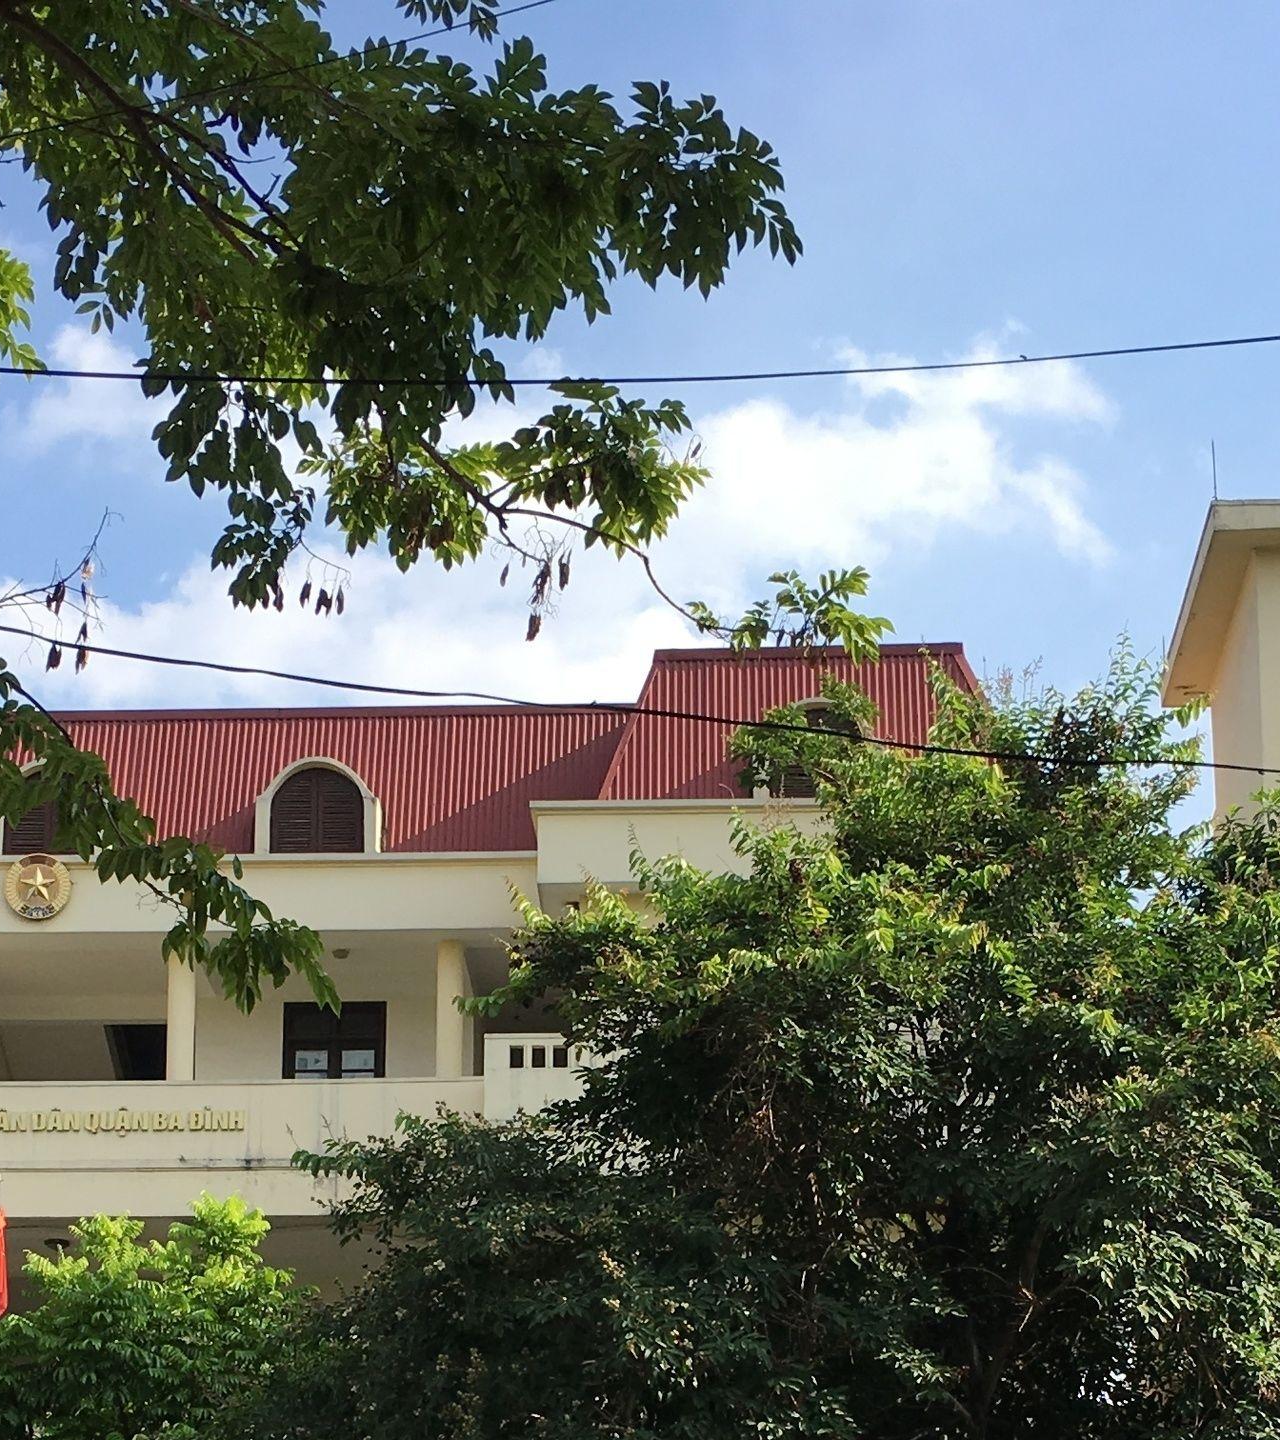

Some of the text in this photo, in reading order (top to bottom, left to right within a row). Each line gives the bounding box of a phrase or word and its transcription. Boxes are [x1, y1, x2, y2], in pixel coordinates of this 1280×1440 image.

[31, 1108, 80, 1132] DÂN
[84, 1107, 149, 1137] QUẬN
[152, 1111, 184, 1132] BA
[189, 1106, 245, 1132] ĐÌNH
